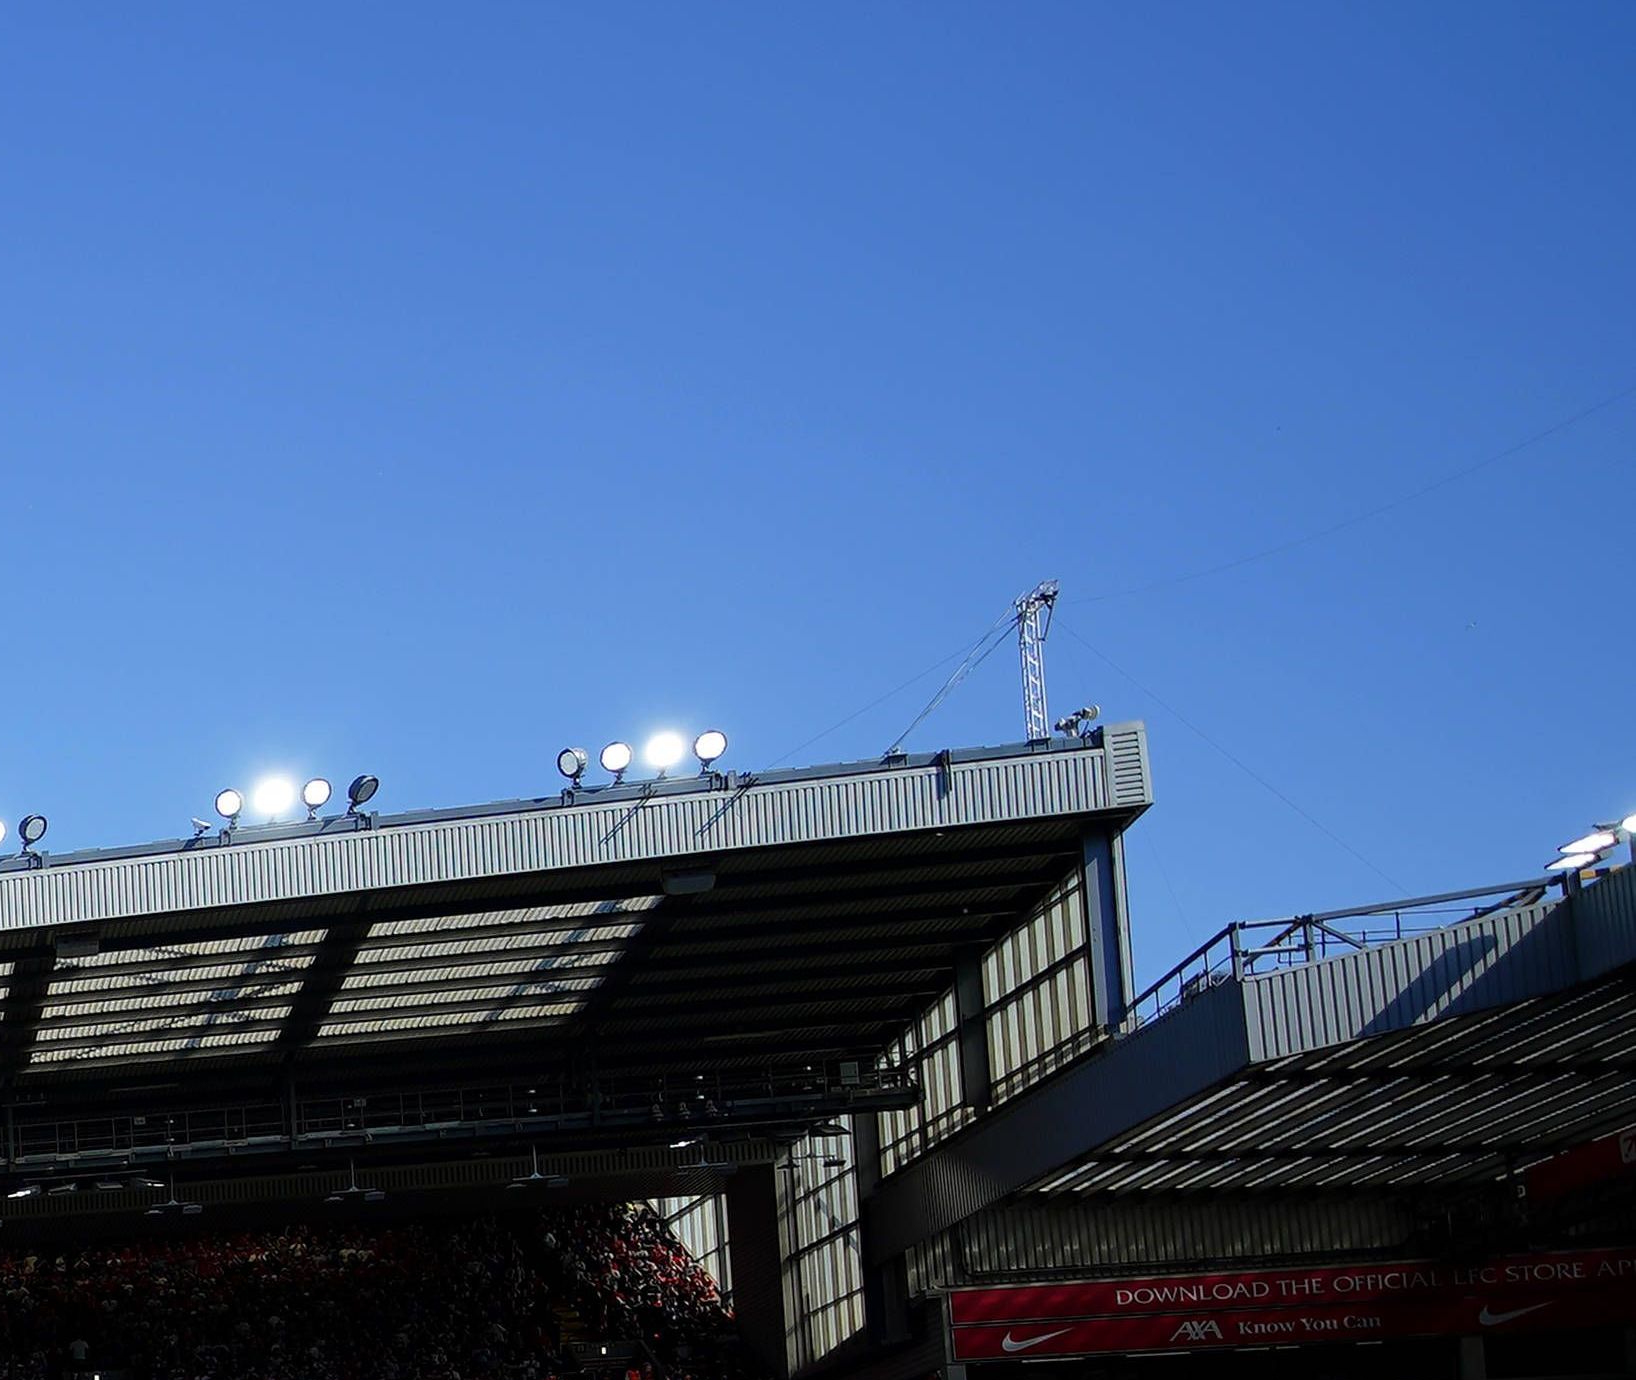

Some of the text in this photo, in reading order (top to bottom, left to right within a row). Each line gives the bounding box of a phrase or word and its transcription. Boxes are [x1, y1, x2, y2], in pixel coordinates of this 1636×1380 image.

[1116, 1259, 1636, 1306] DOWNLOAD THE OFFICIAL LFC STORE AP
[1169, 1313, 1383, 1342] AXA Know You Can
